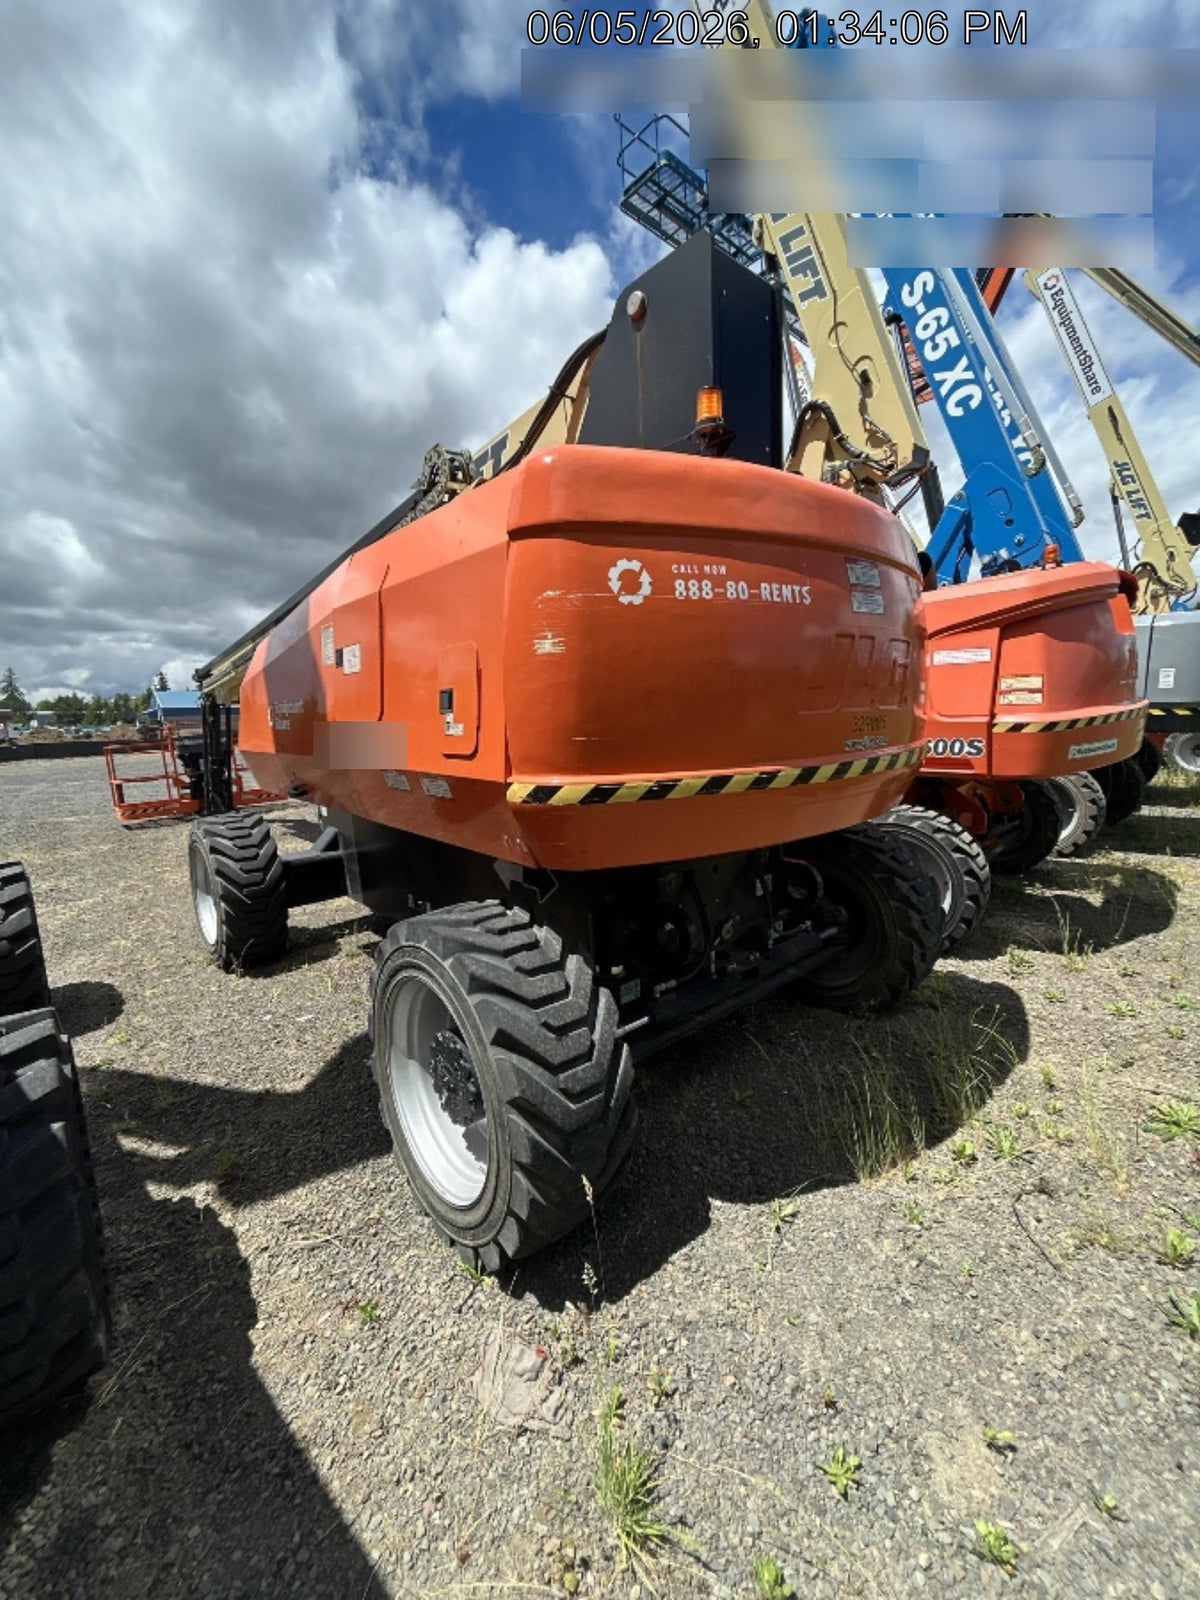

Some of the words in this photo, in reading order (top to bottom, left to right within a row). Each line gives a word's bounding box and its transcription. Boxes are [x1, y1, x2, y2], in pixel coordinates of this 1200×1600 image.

[778, 224, 829, 304] LIFT
[901, 271, 961, 362] S-65
[933, 354, 983, 417] XC
[1050, 288, 1102, 396] EquipmentShare
[1112, 460, 1137, 486] JLG
[1125, 488, 1152, 520] LIFT
[671, 564, 699, 574] CALL
[704, 565, 727, 575] NOW
[674, 579, 812, 605] 888-80-RENTS
